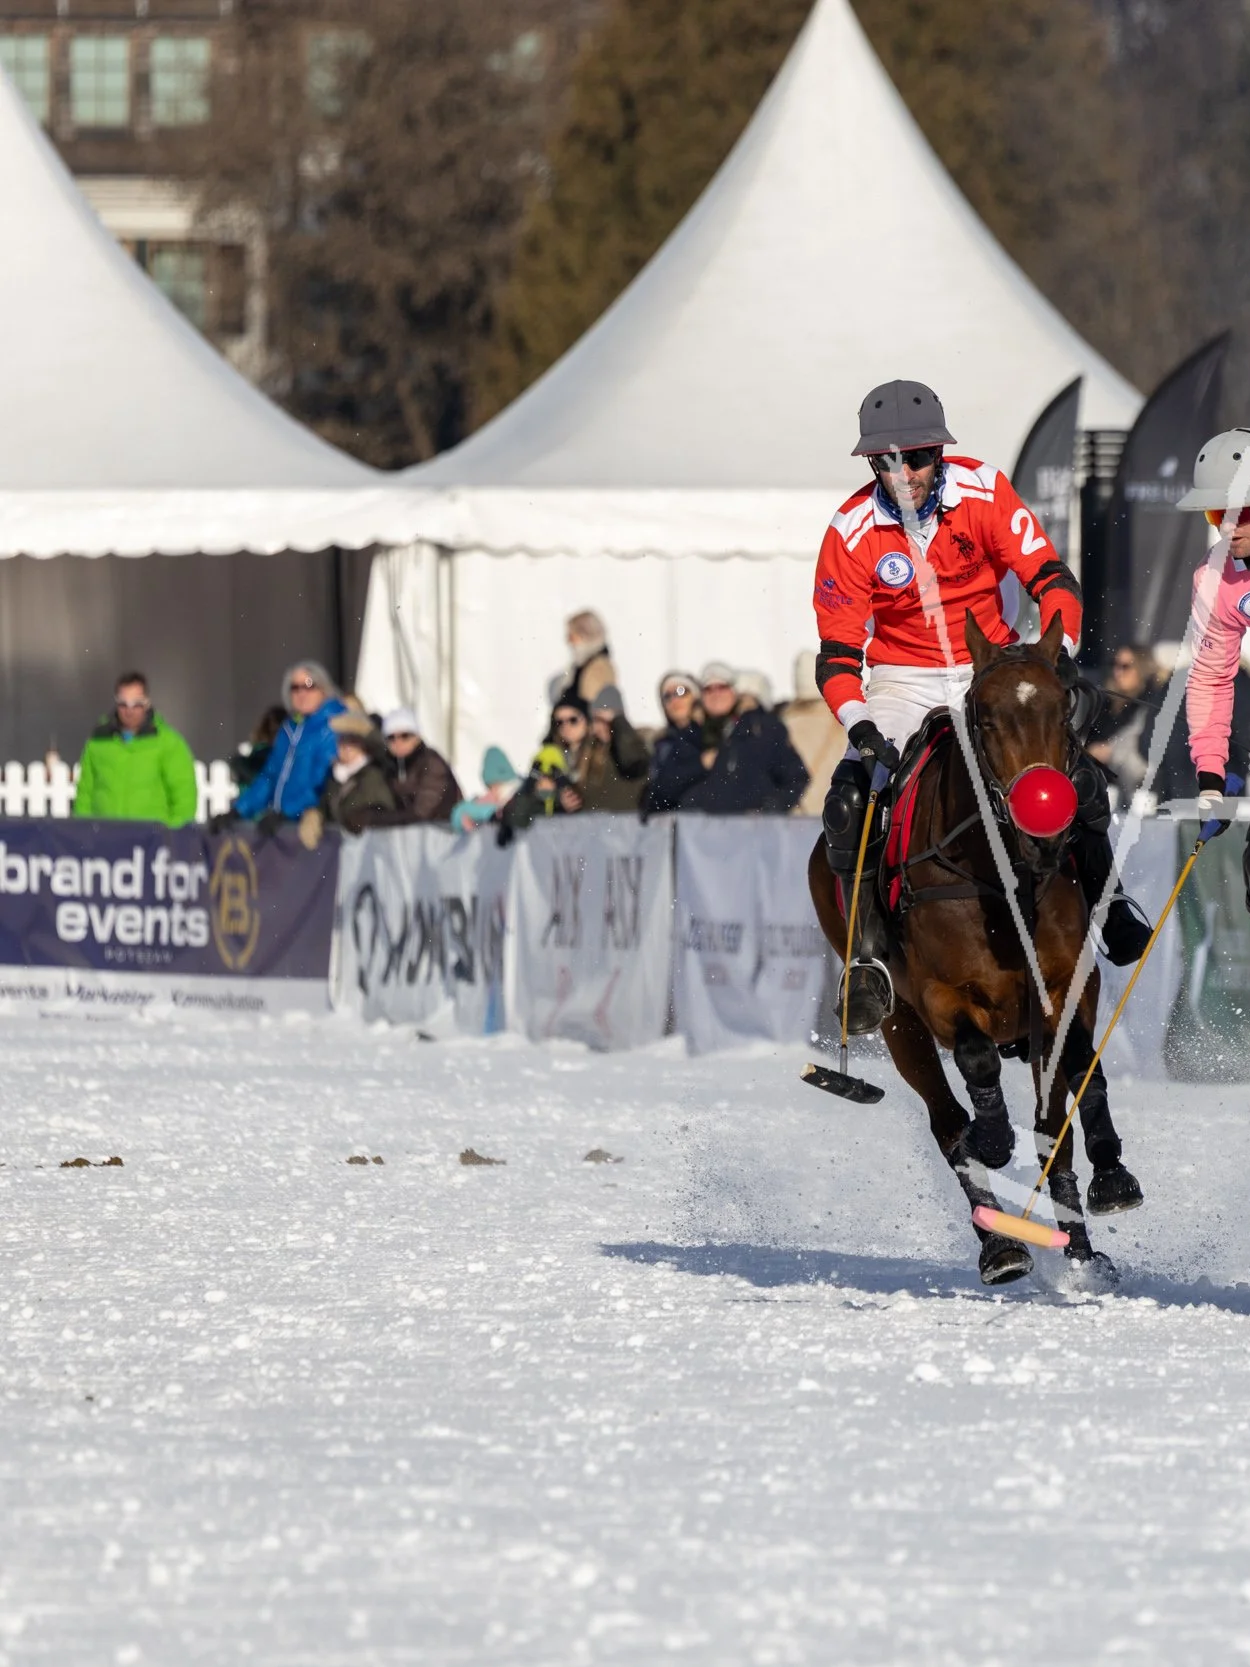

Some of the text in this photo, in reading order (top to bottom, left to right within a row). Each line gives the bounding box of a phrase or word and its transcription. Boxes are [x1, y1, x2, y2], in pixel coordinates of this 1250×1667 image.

[1011, 507, 1047, 556] 2
[0, 840, 209, 902] brand for
[56, 900, 210, 948] events
